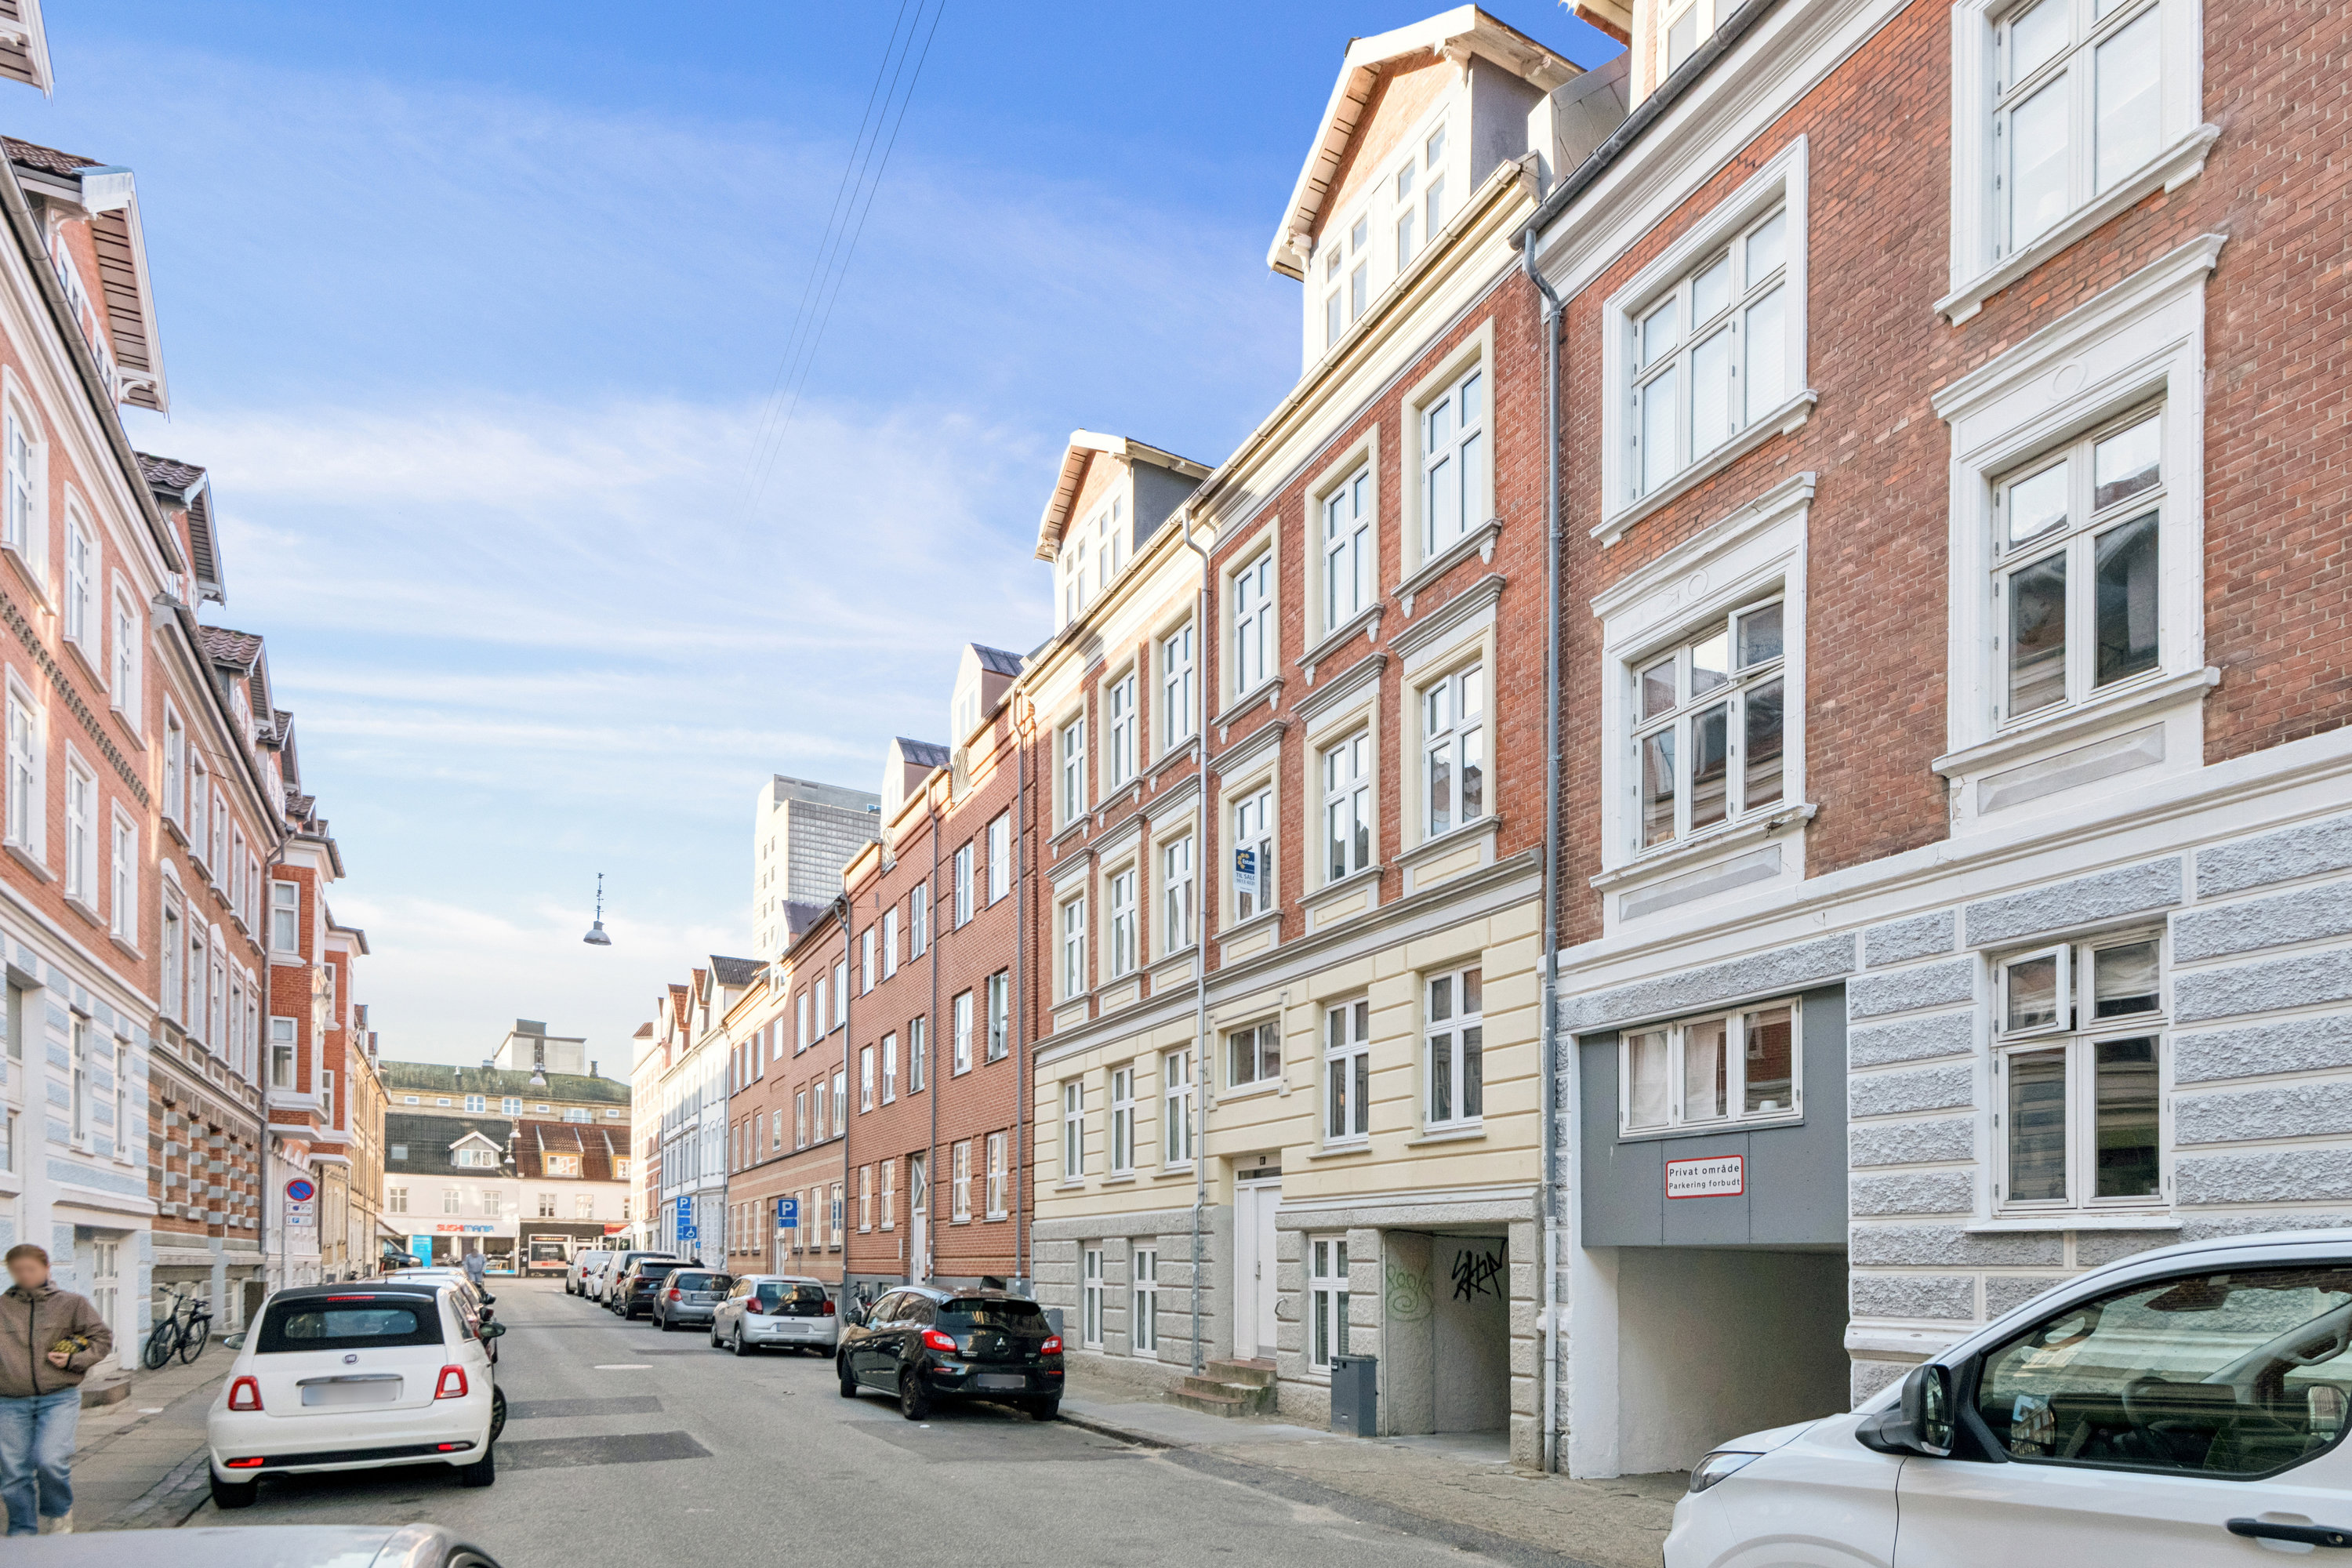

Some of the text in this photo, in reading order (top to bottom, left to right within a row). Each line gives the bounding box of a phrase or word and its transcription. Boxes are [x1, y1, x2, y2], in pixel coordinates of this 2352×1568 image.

[1669, 1163, 1740, 1177] Privat område
[1669, 1178, 1740, 1189] Parkering forbudt
[680, 1198, 688, 1208] P
[782, 1201, 793, 1215] P
